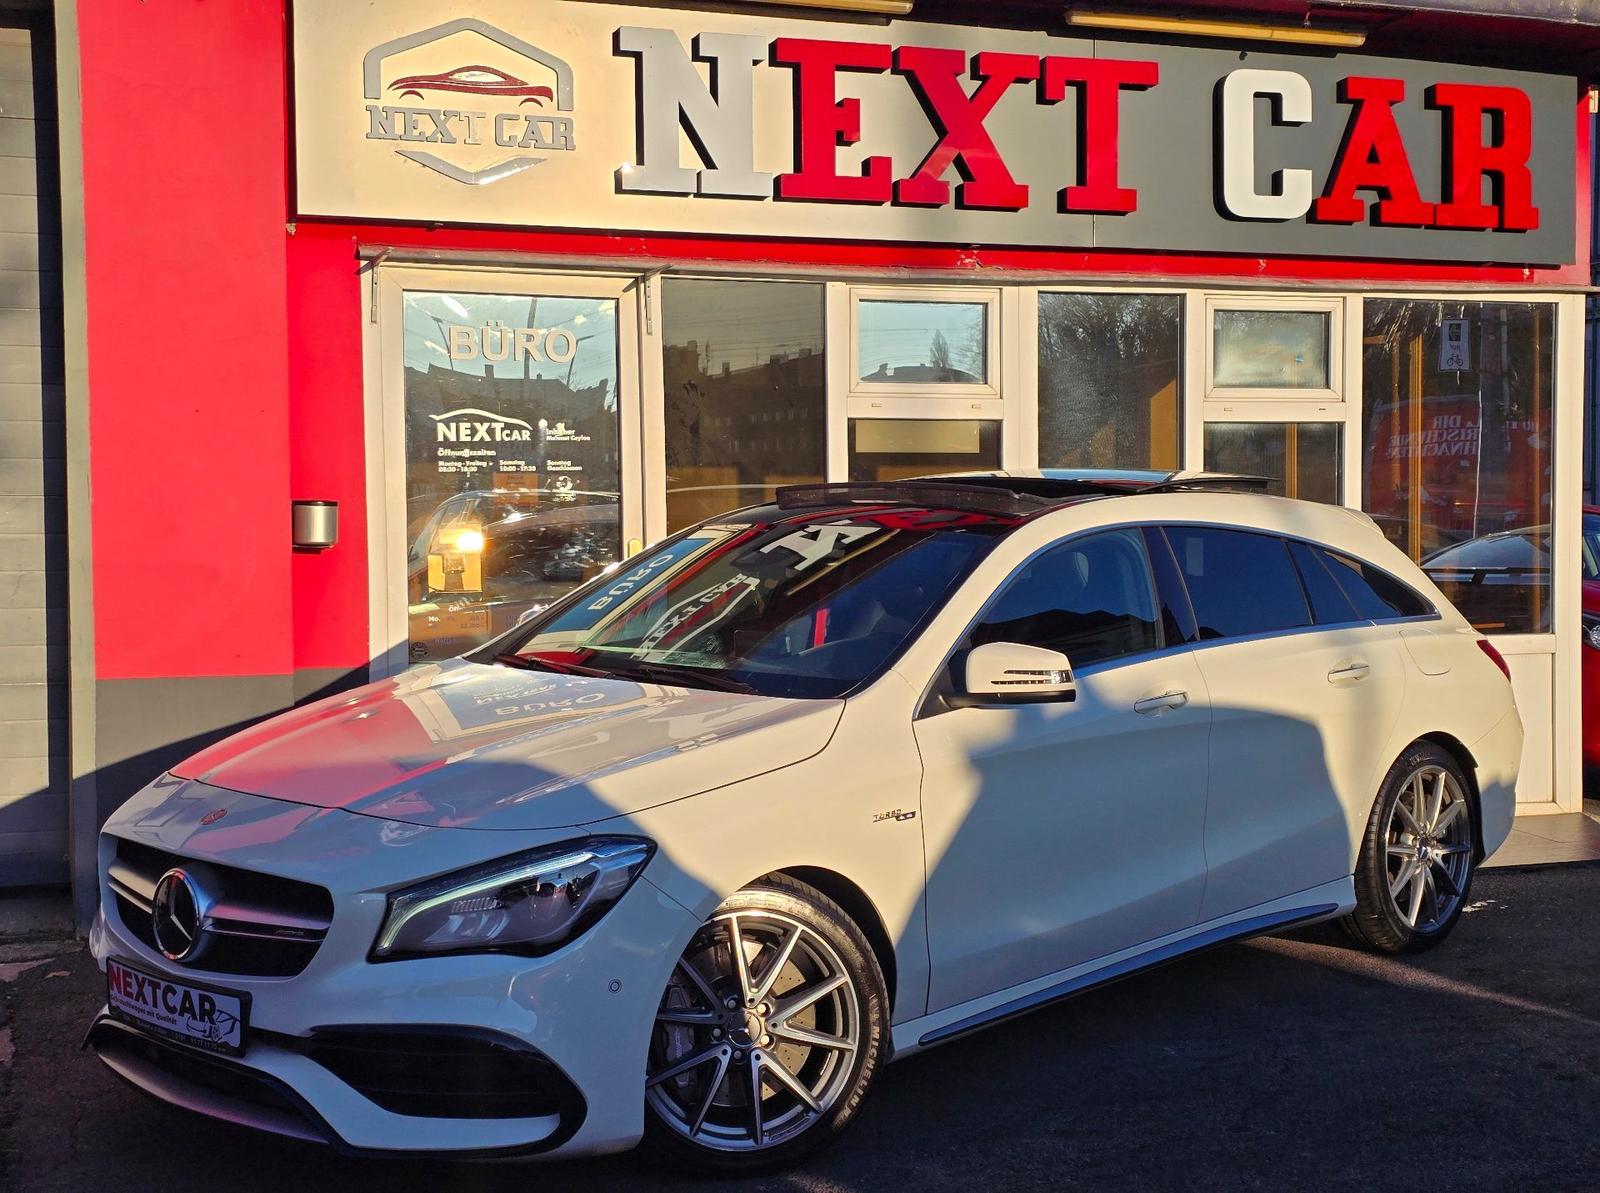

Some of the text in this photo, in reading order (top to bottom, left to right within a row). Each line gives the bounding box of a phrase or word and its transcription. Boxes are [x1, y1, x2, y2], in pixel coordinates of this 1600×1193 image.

[365, 105, 577, 151] NEXT CAR
[612, 26, 1539, 232] NEXT CAR
[448, 319, 578, 363] BÜRO
[873, 808, 902, 822] TURBO
[108, 965, 217, 1025] NEXTCAR
[848, 1025, 881, 1107] MICHELIN
